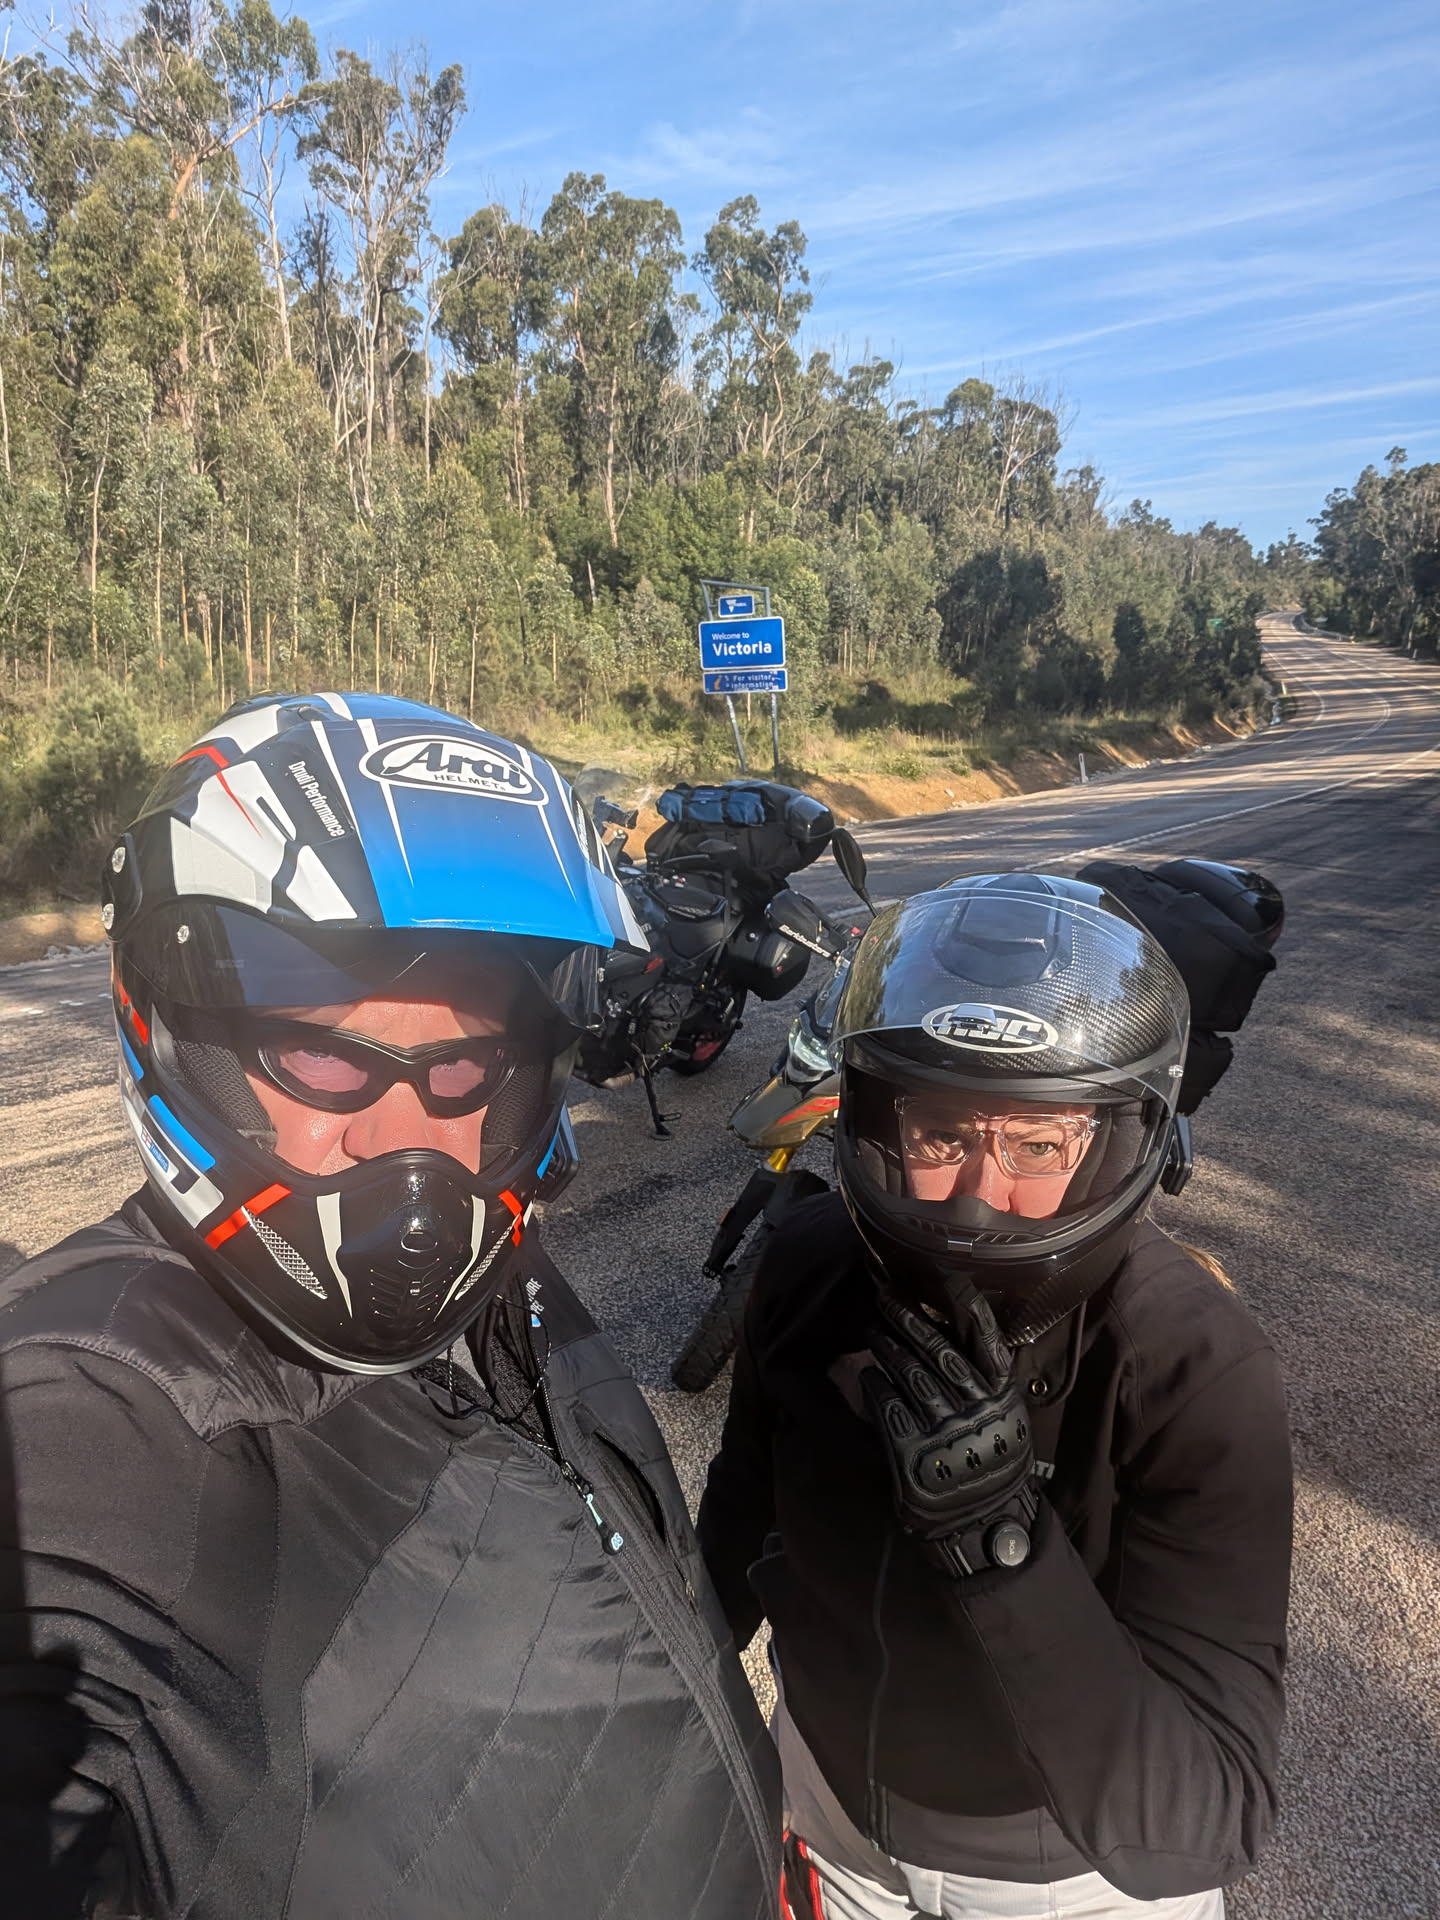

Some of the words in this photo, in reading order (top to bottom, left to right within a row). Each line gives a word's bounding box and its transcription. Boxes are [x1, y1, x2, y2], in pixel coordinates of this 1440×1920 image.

[712, 632, 740, 641] Welcome
[712, 641, 772, 656] Victoria
[288, 760, 316, 785] Drudi
[381, 743, 527, 788] Arai
[434, 774, 500, 789] HELMET
[301, 781, 345, 837] Performance
